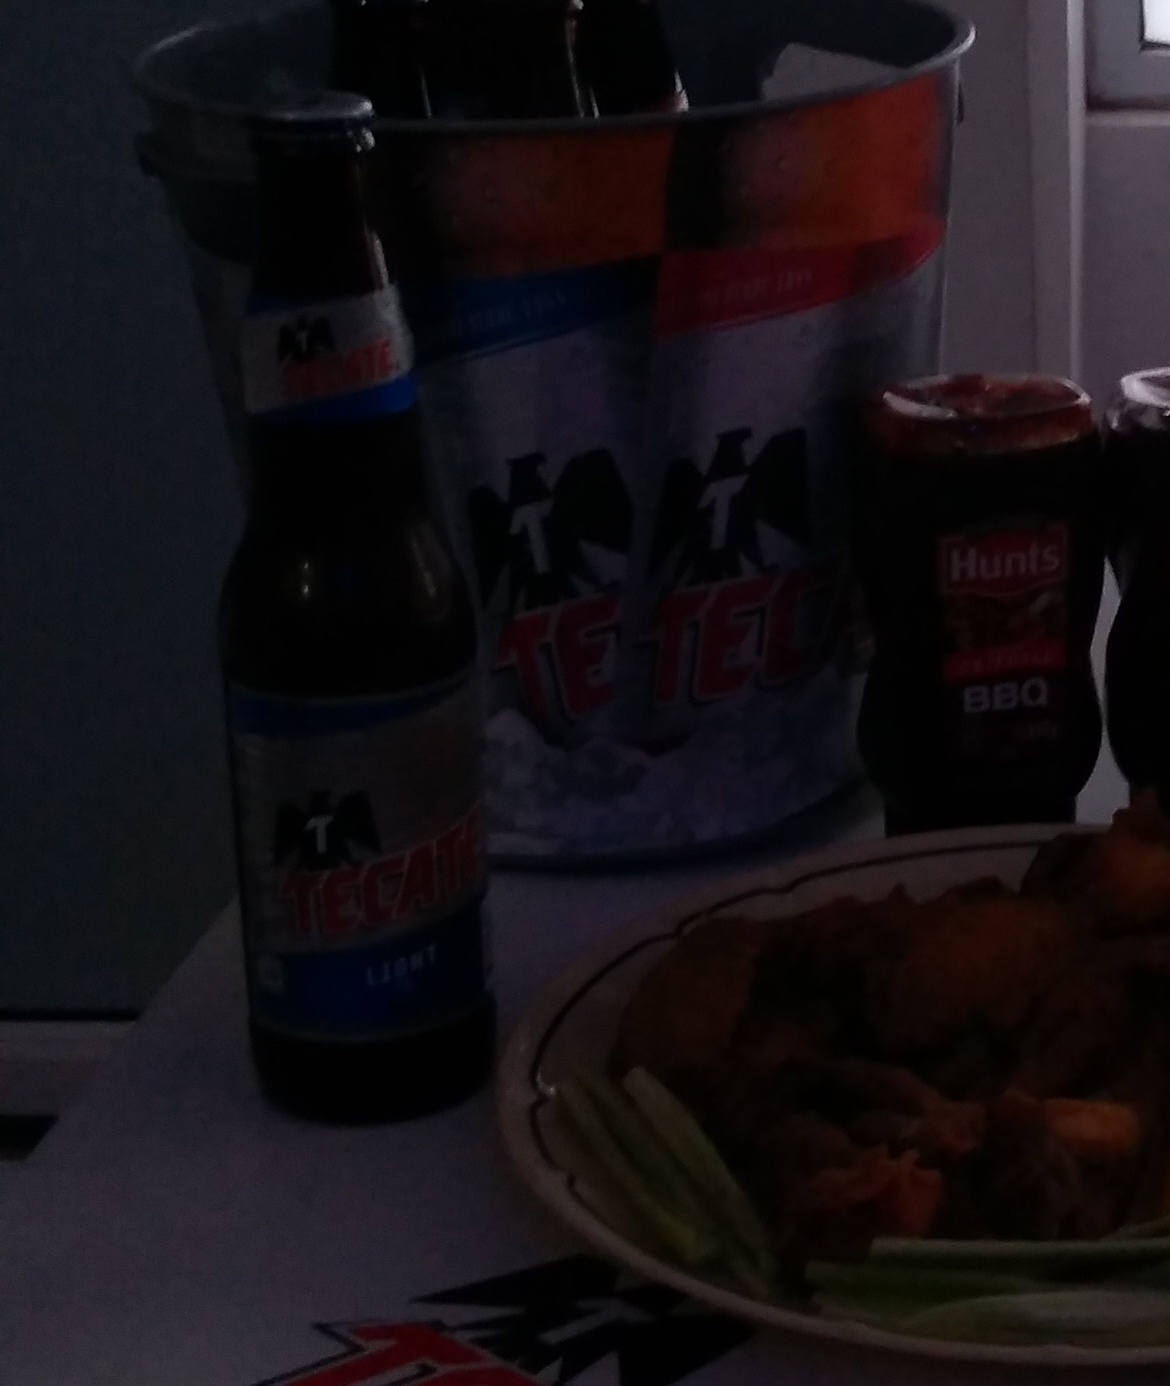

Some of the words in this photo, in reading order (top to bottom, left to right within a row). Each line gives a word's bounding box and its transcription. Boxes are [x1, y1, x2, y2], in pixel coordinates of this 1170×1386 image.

[962, 676, 1050, 714] BBQ
[281, 803, 482, 935] TECATE
[366, 943, 438, 988] LIGHT
